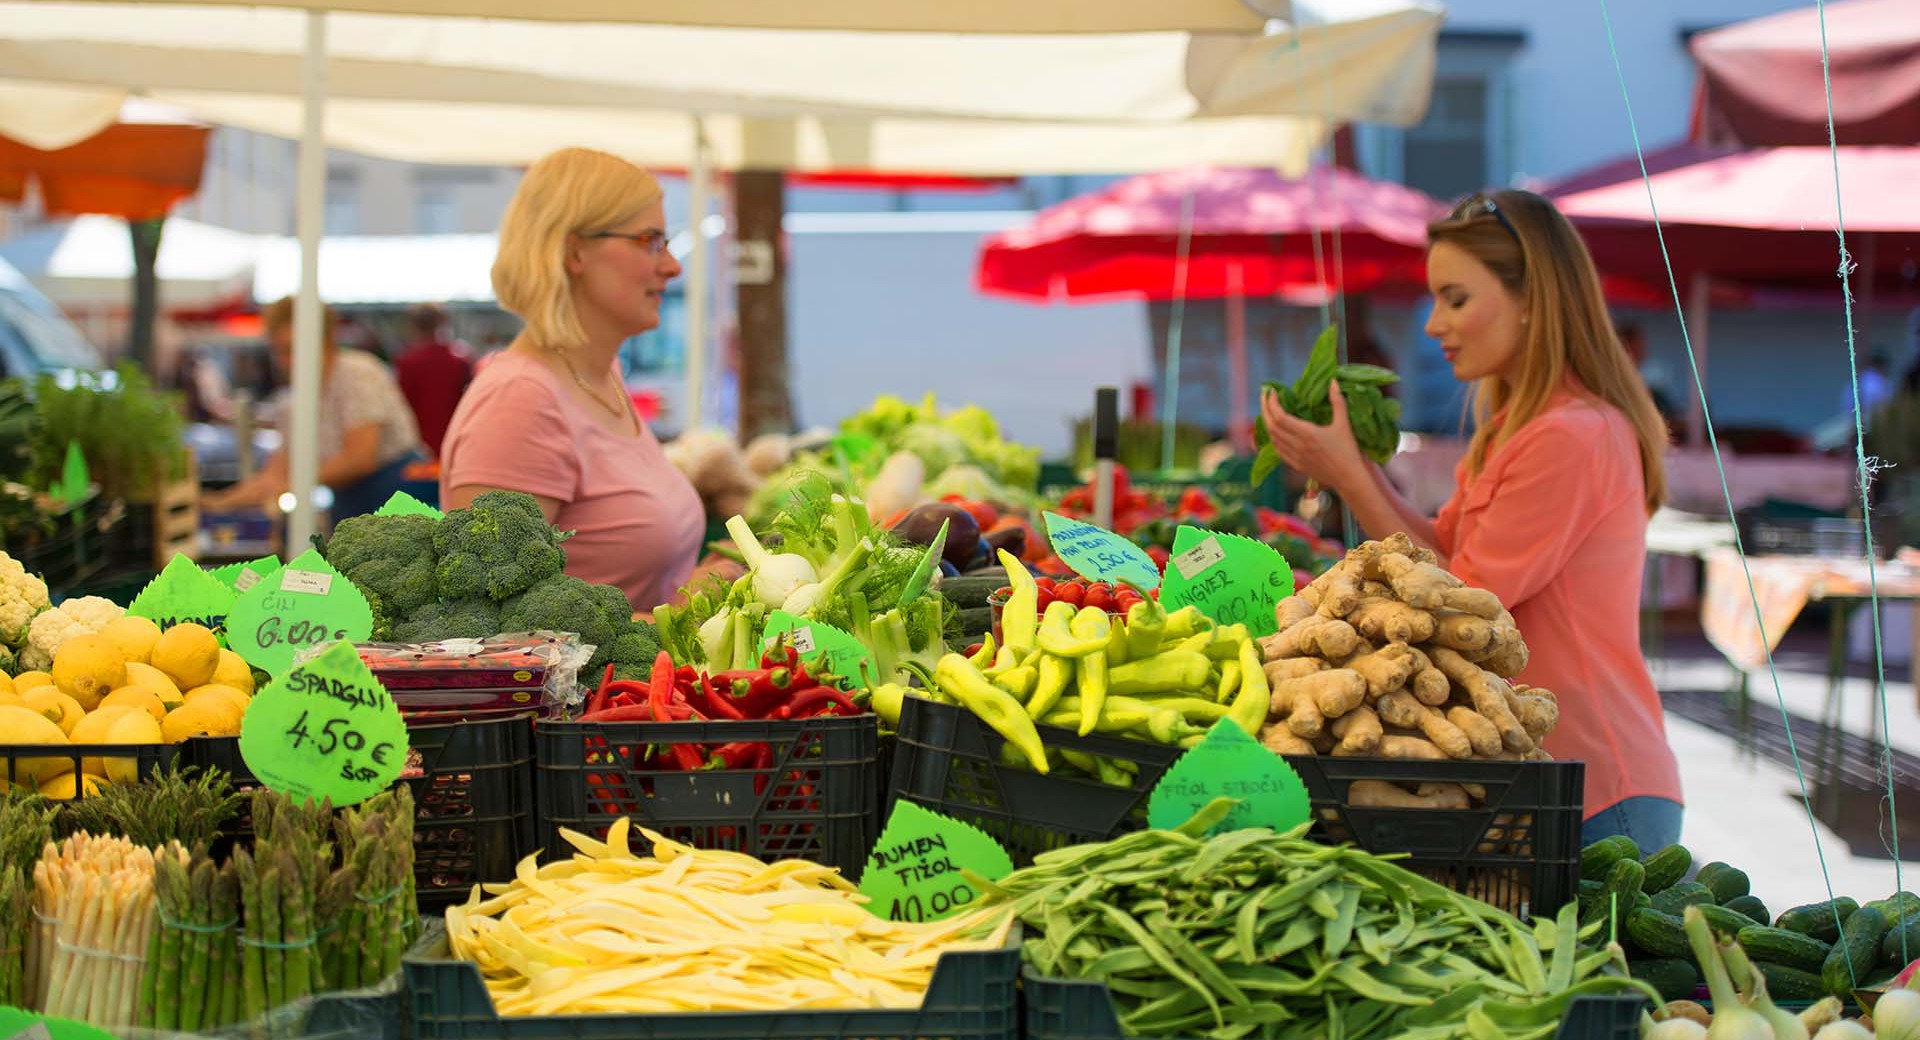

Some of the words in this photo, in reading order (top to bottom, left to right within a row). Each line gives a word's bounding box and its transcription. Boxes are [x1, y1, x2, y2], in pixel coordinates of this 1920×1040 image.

[1175, 570, 1234, 606] INGVER
[256, 616, 327, 648] 6.00
[286, 710, 365, 755] 4.50
[371, 743, 394, 765] €
[895, 857, 960, 887] FIŽOL
[889, 885, 973, 923] 10.00
